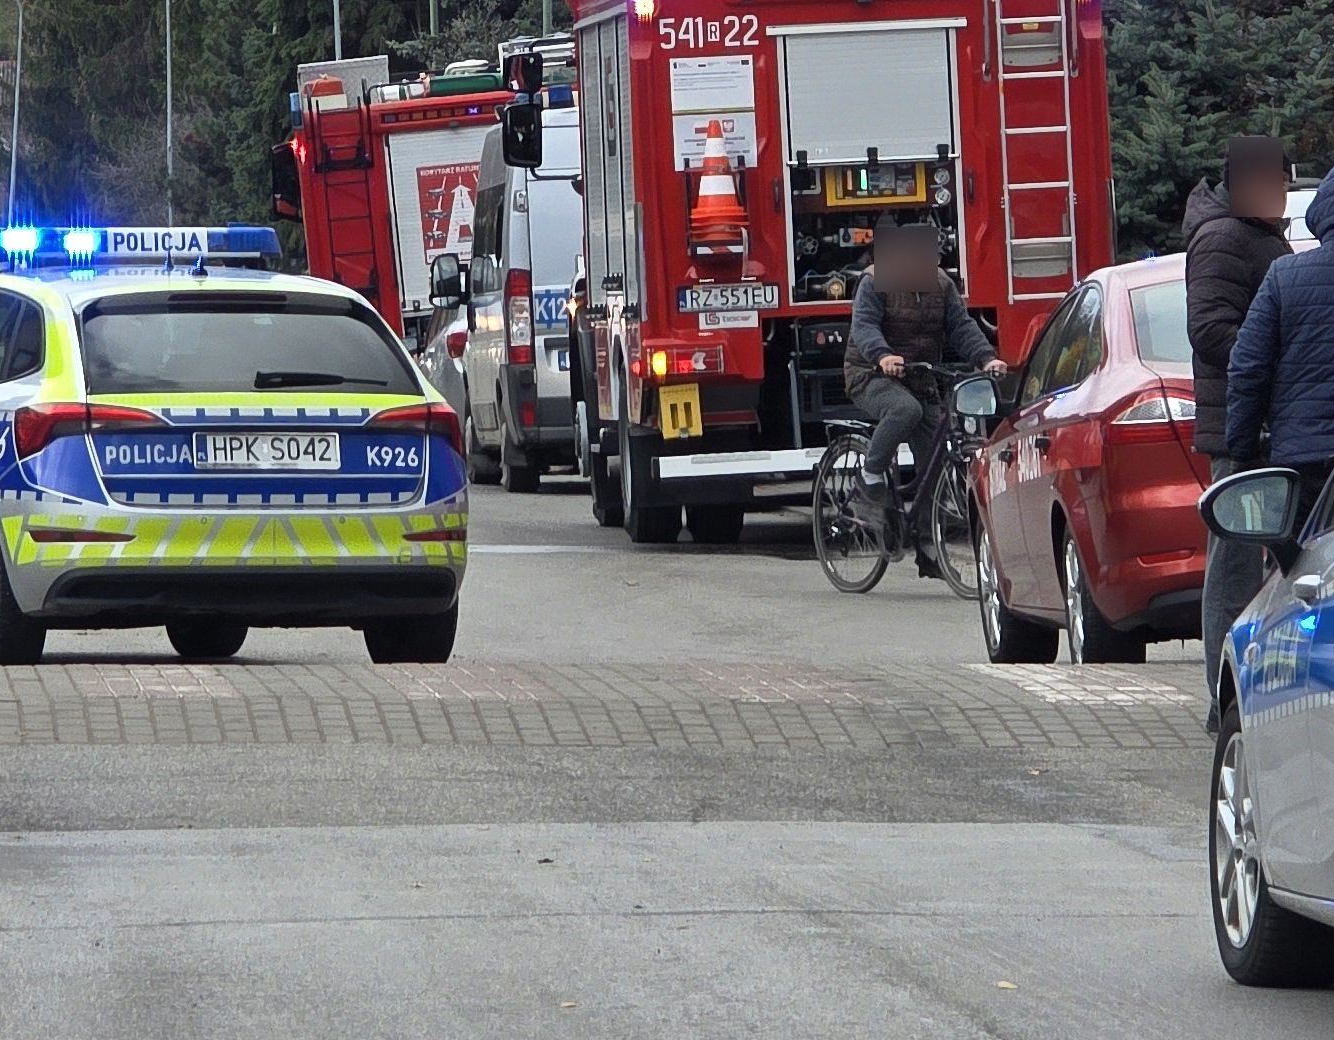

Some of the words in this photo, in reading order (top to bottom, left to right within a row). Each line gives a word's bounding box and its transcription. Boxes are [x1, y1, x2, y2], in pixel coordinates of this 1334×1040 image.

[113, 232, 202, 252] POLICJA
[690, 289, 713, 308] RZ
[720, 286, 775, 307] 551EU
[535, 297, 568, 320] K12
[105, 444, 193, 464] POLICJA
[212, 436, 260, 461] HPK
[270, 437, 332, 462] S042
[367, 446, 419, 467] K926
